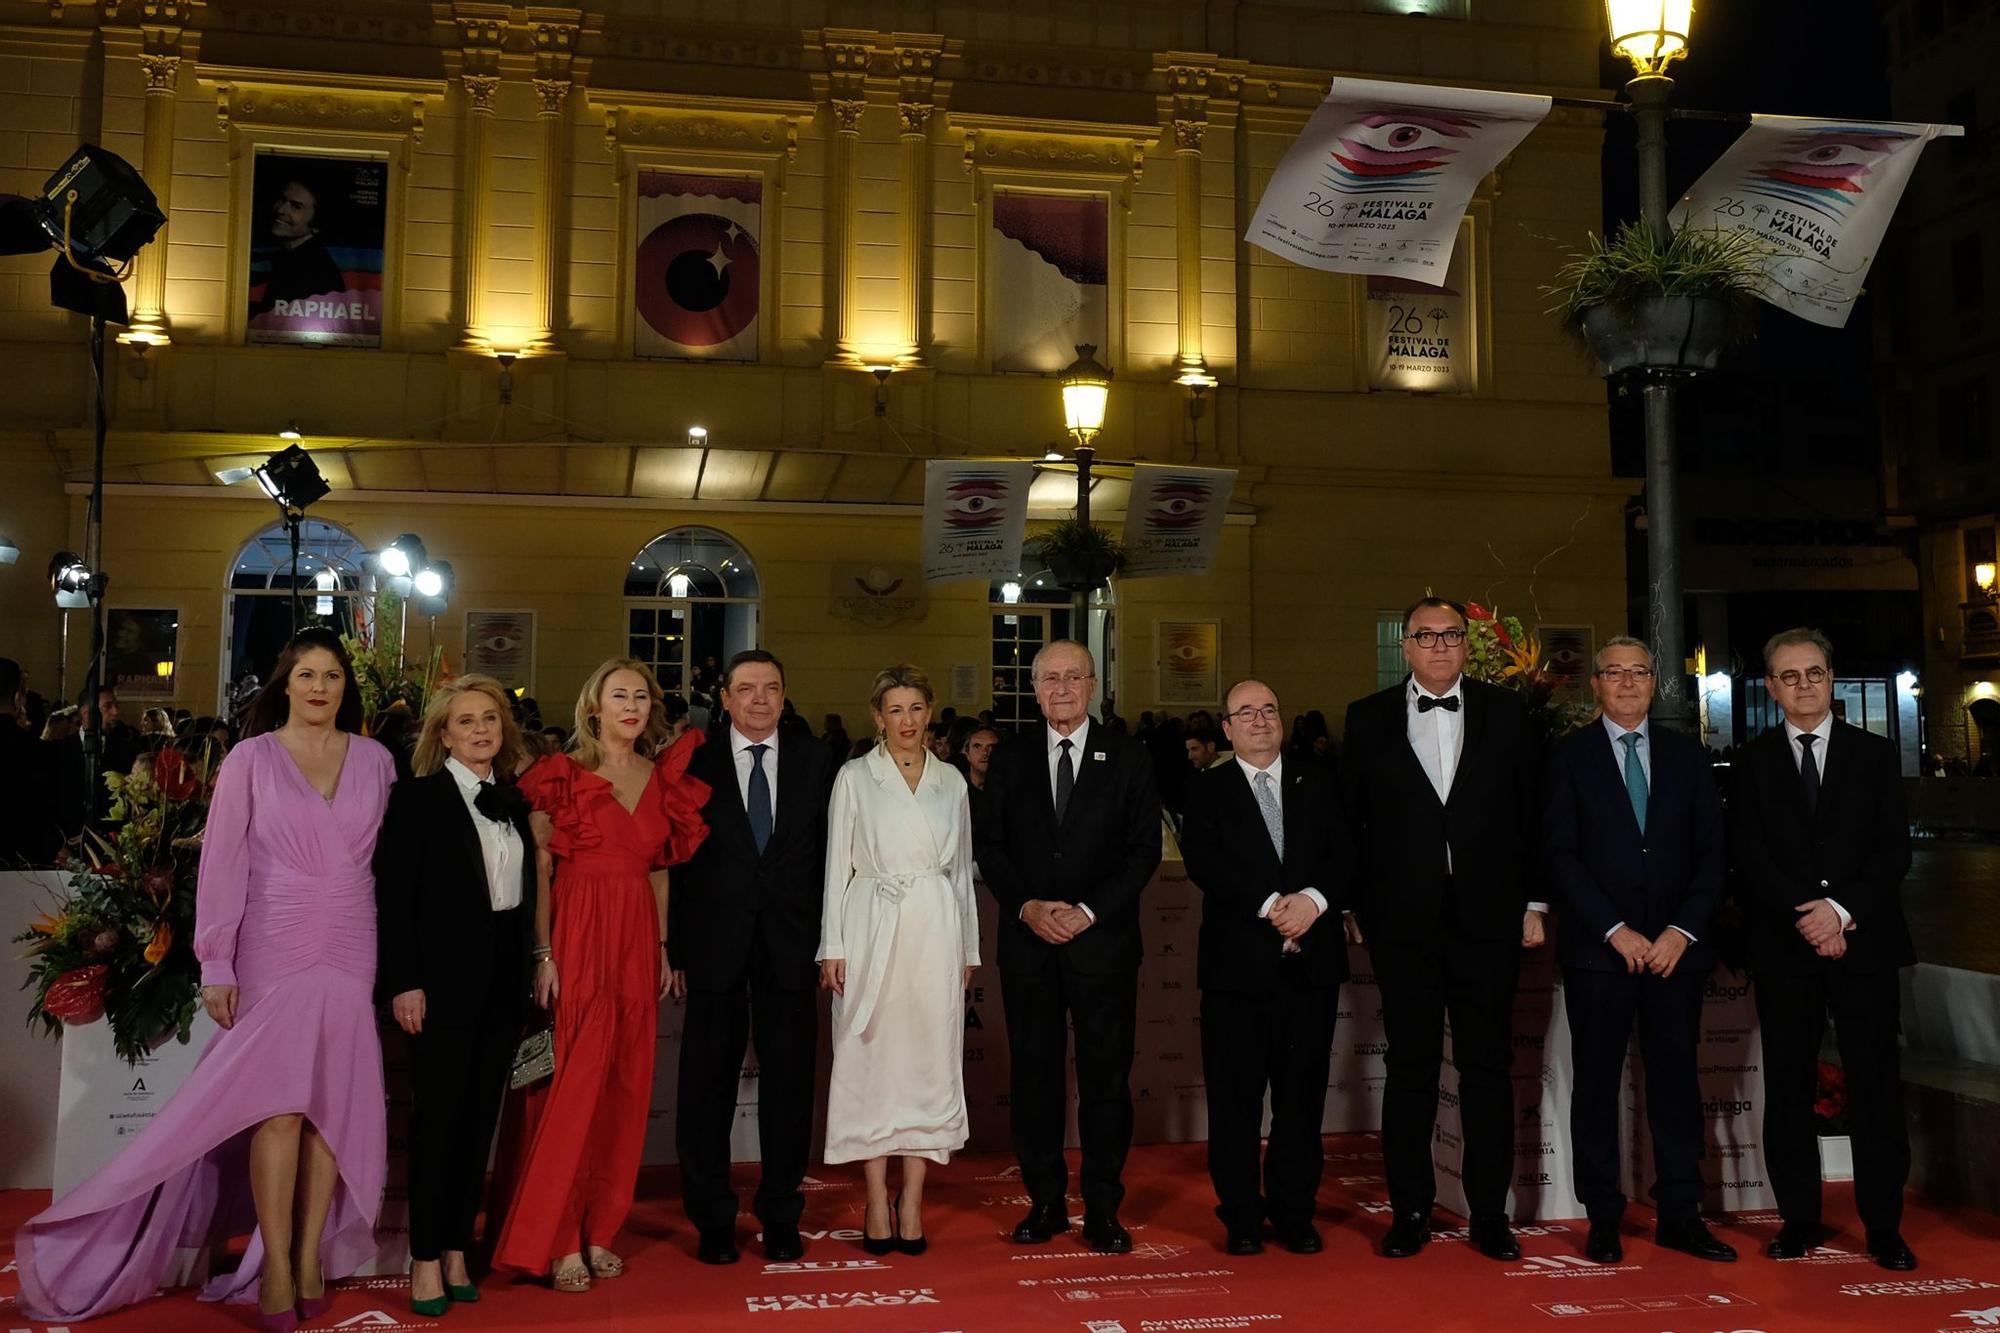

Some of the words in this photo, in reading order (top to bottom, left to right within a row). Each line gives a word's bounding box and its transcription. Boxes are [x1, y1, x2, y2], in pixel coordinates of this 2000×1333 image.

[1304, 192, 1334, 217] 26
[1363, 201, 1414, 209] FESTIVAL
[1713, 197, 1745, 217] 26
[1775, 209, 1825, 238] FESTIVAL
[1826, 234, 1838, 248] DE
[1755, 231, 1785, 247] MARZO
[274, 299, 376, 321] RAPHAEL
[1389, 305, 1422, 334] 26
[1389, 336, 1433, 346] FESTIVAL
[1438, 338, 1449, 346] DE
[1407, 364, 1431, 372] MARZO
[764, 1260, 880, 1271] SUR
[745, 1293, 887, 1304] FESTIVAL
[898, 1288, 935, 1297] DE
[1839, 1282, 2000, 1296] VICTORIA
[1140, 1314, 1282, 1328] Ayuntamiento
